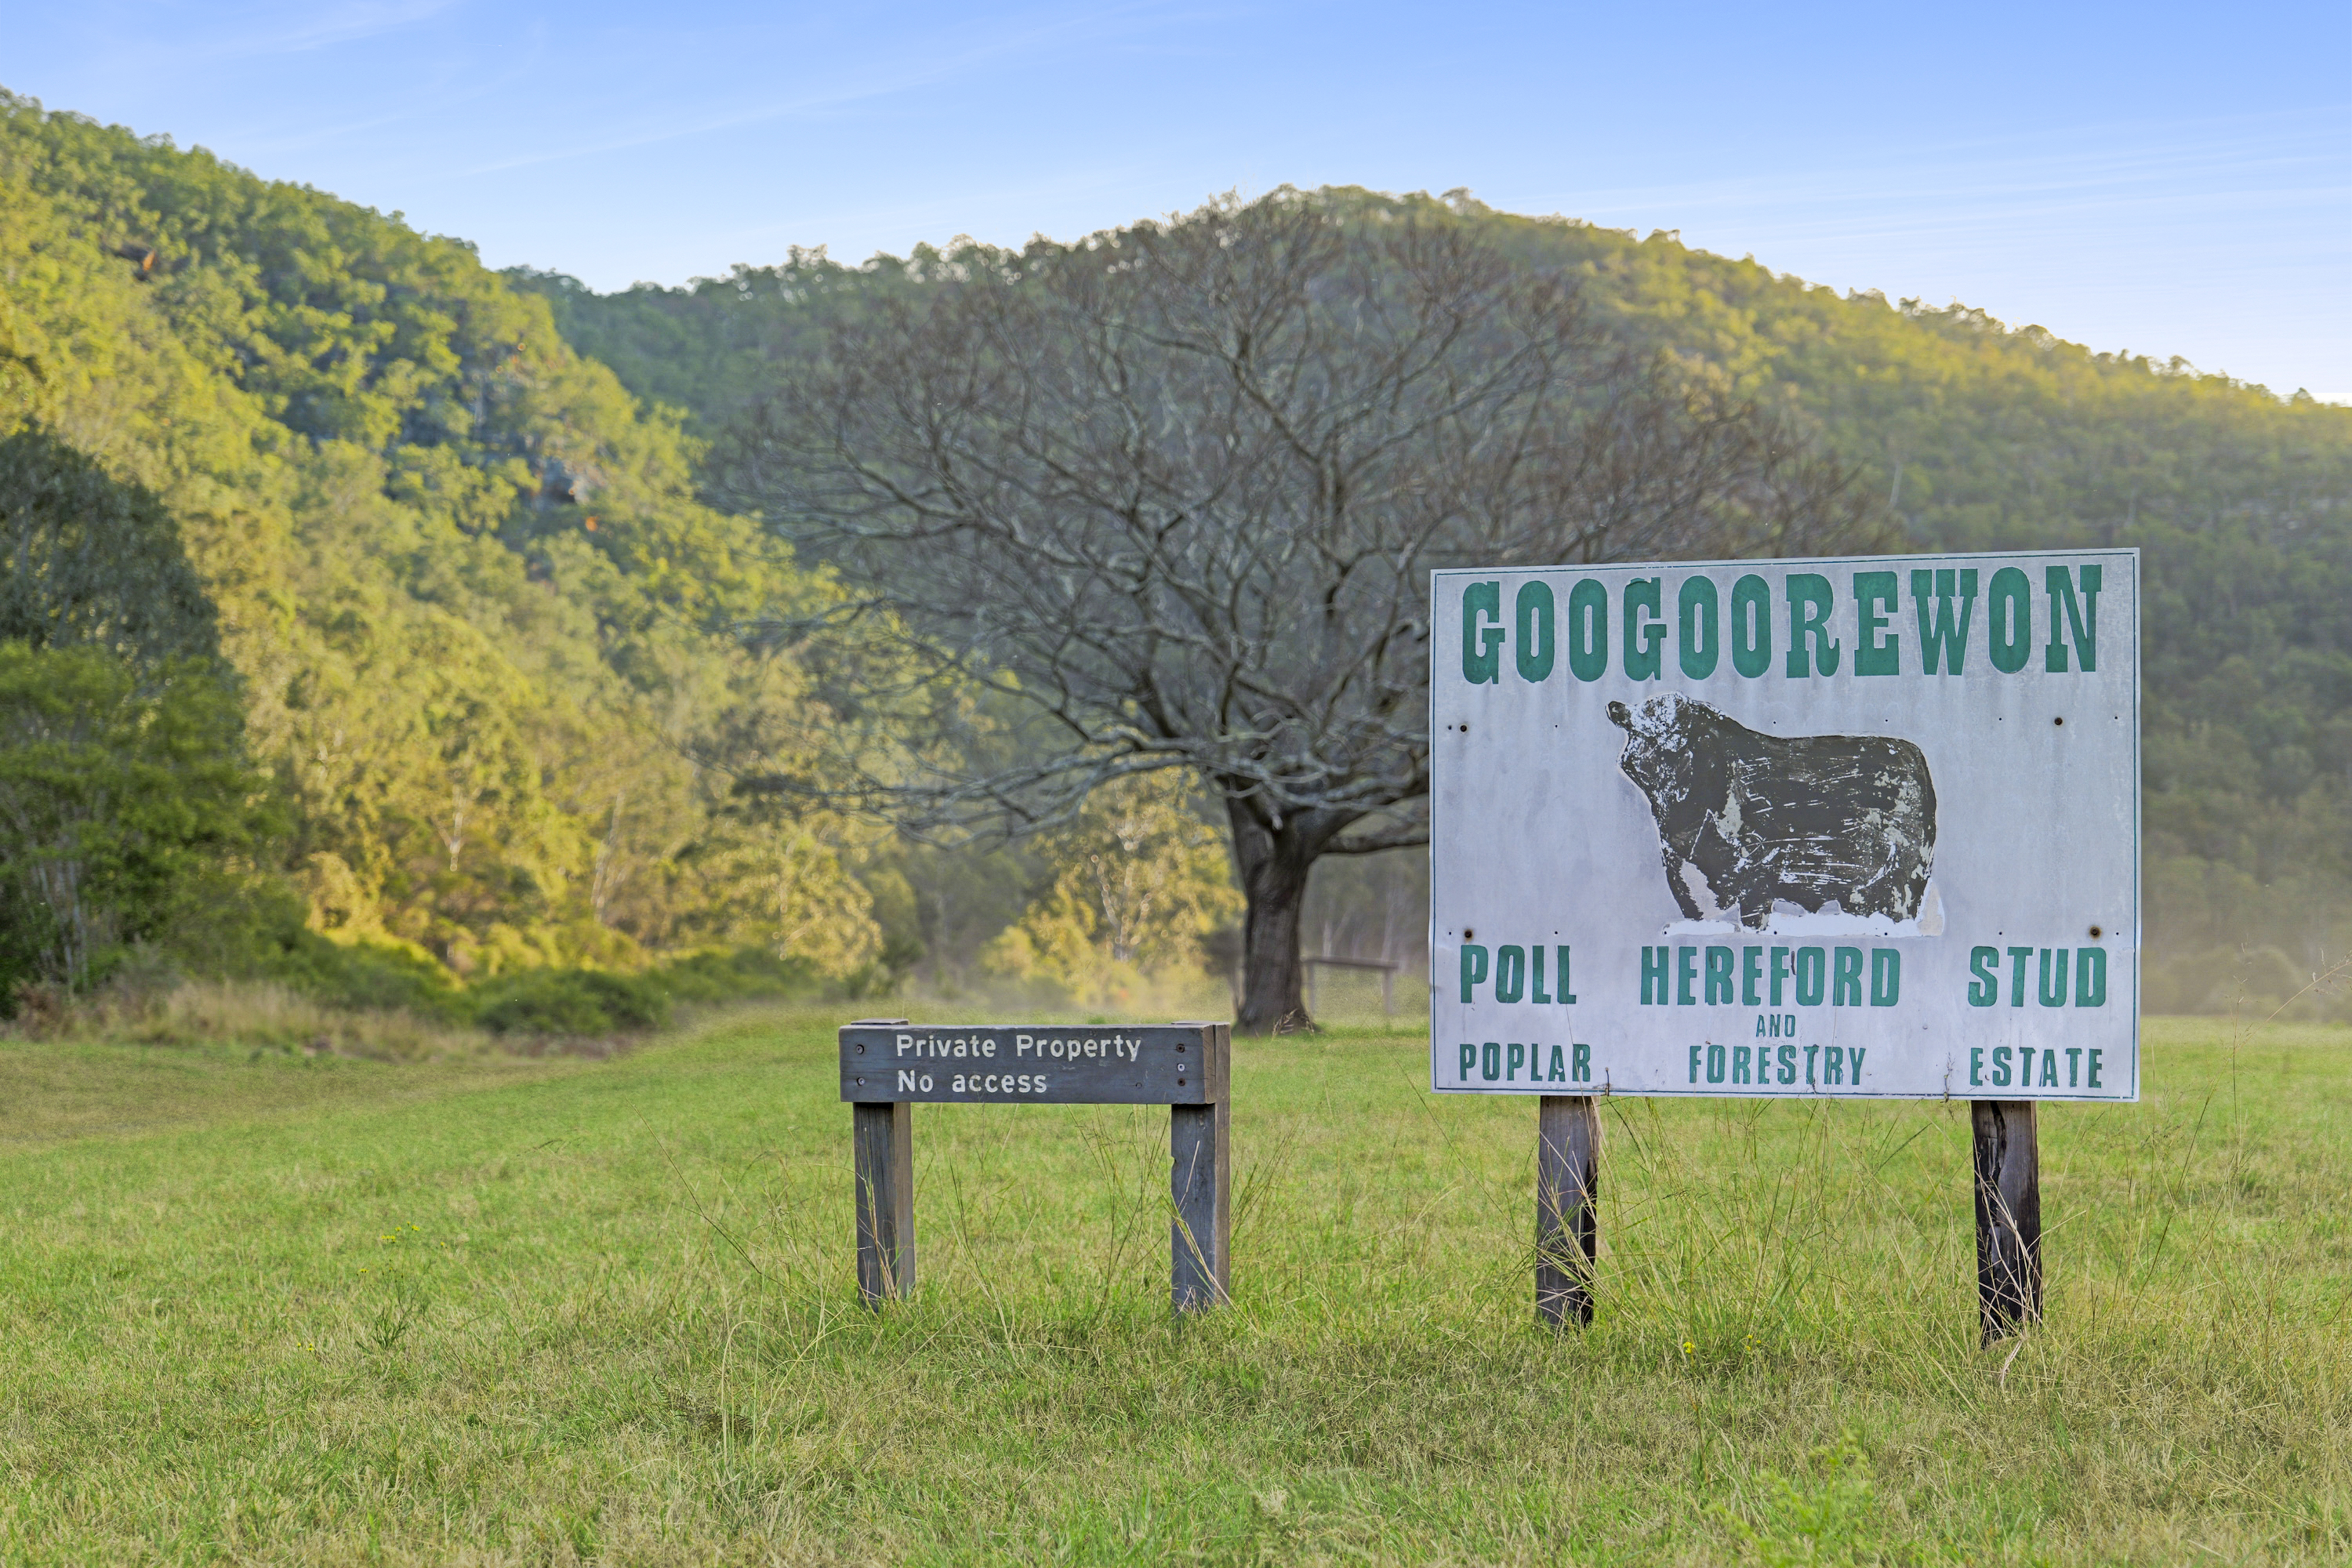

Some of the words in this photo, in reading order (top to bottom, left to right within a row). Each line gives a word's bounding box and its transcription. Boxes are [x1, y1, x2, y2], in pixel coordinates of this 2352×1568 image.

[1462, 564, 2102, 685] GOOGOOREWON
[1460, 944, 1577, 1004] POLL
[1641, 945, 1901, 1006] HEREFORD
[1967, 946, 2107, 1008] STUD
[1756, 1014, 1796, 1038] AND
[896, 1035, 996, 1057] Private
[1017, 1035, 1141, 1062] Property
[1459, 1042, 1591, 1082] POPLAR
[1689, 1045, 1866, 1085] FORESTRY
[1969, 1047, 2103, 1088] ESTATE
[898, 1070, 933, 1092] No
[952, 1073, 1048, 1093] access
